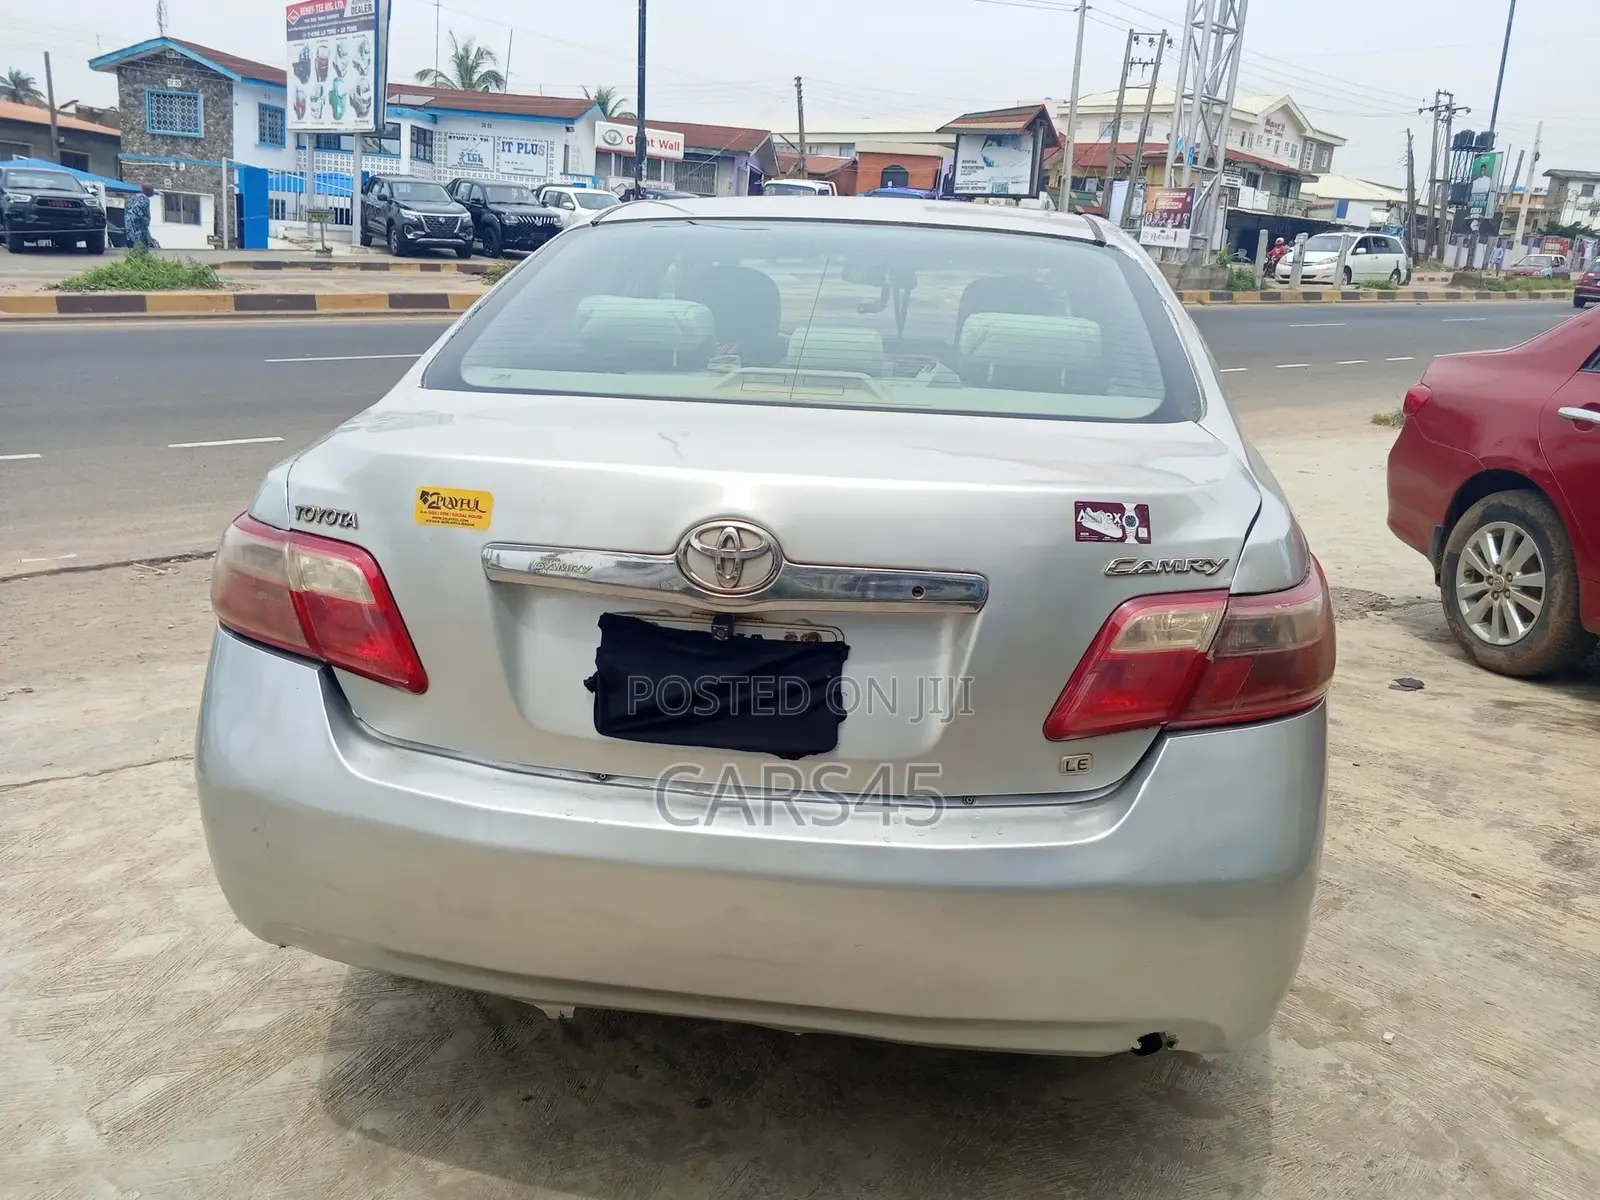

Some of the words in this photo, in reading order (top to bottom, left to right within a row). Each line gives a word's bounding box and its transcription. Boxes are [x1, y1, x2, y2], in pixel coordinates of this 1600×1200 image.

[350, 3, 373, 15] DEALER
[501, 140, 514, 153] IT
[516, 142, 546, 156] PLUS
[659, 139, 680, 152] Wall
[295, 505, 358, 530] TOYOTA
[531, 560, 593, 574] CAMRY
[1104, 556, 1229, 577] CAMRY
[1066, 758, 1088, 772] LE
